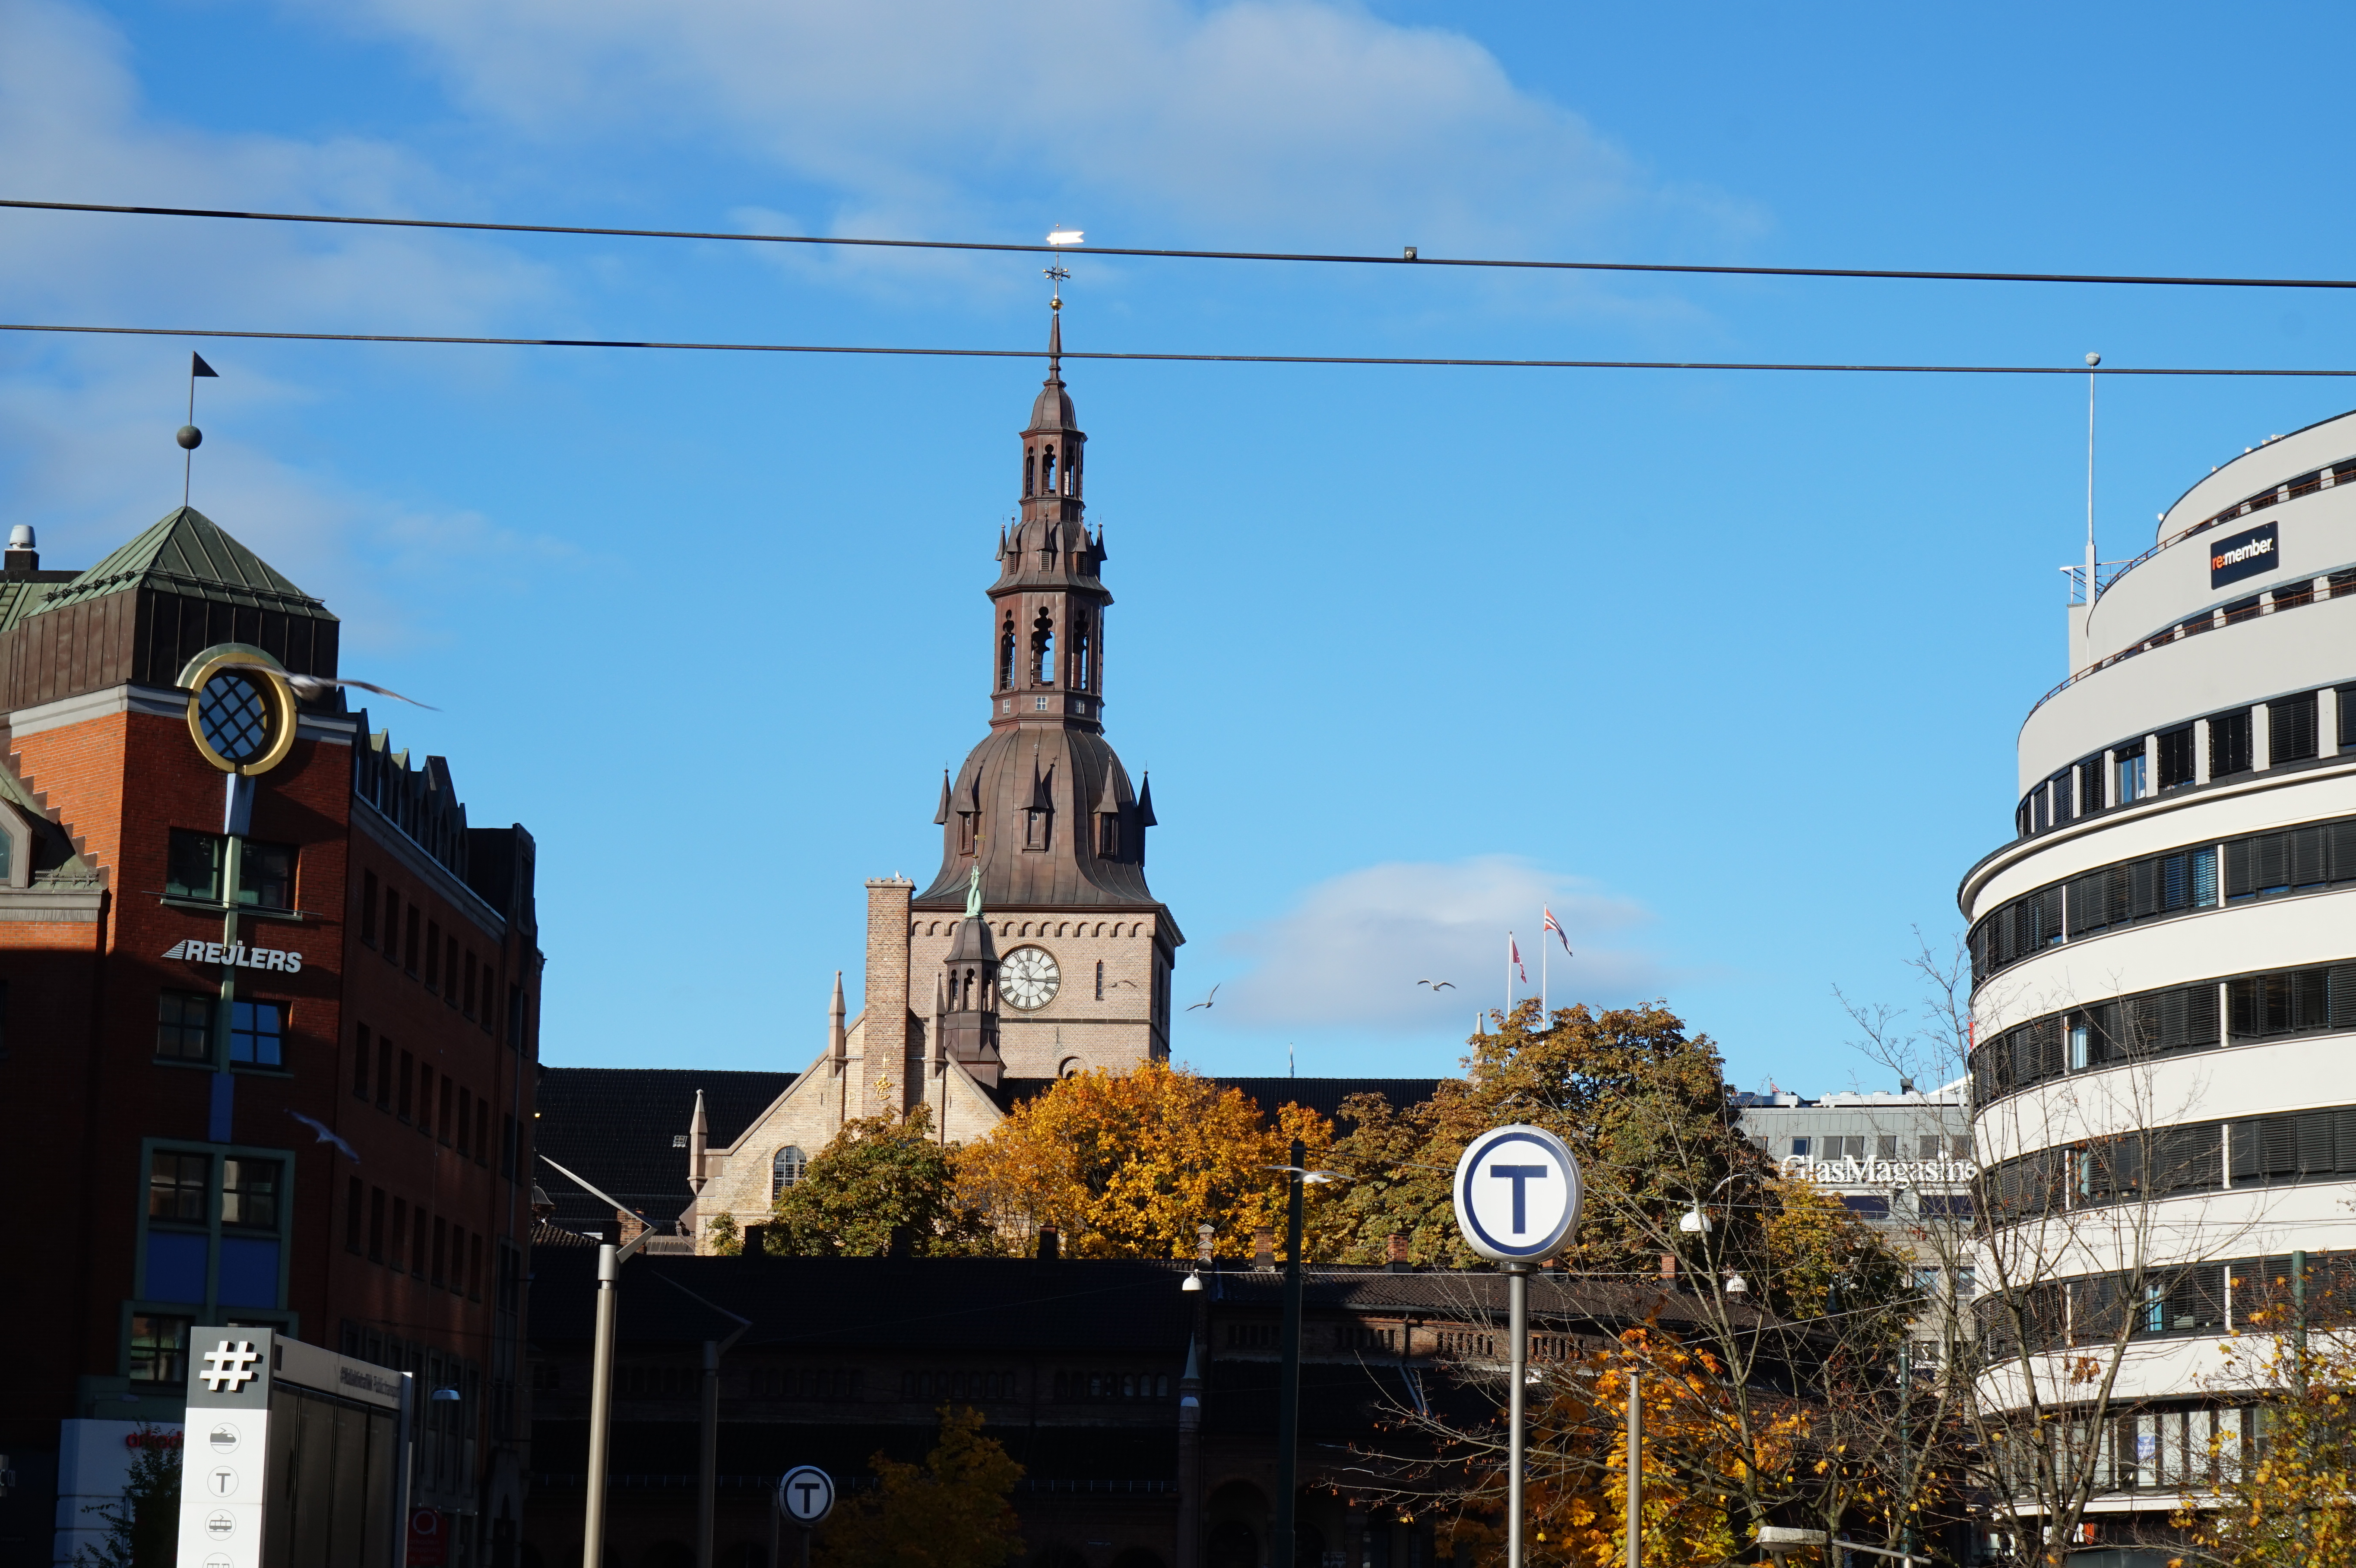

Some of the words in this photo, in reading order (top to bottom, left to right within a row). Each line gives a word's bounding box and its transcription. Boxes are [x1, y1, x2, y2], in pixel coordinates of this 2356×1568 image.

[185, 939, 302, 973] REJLERS
[1490, 1165, 1547, 1234] T
[216, 1473, 231, 1493] T
[795, 1483, 820, 1514] T
